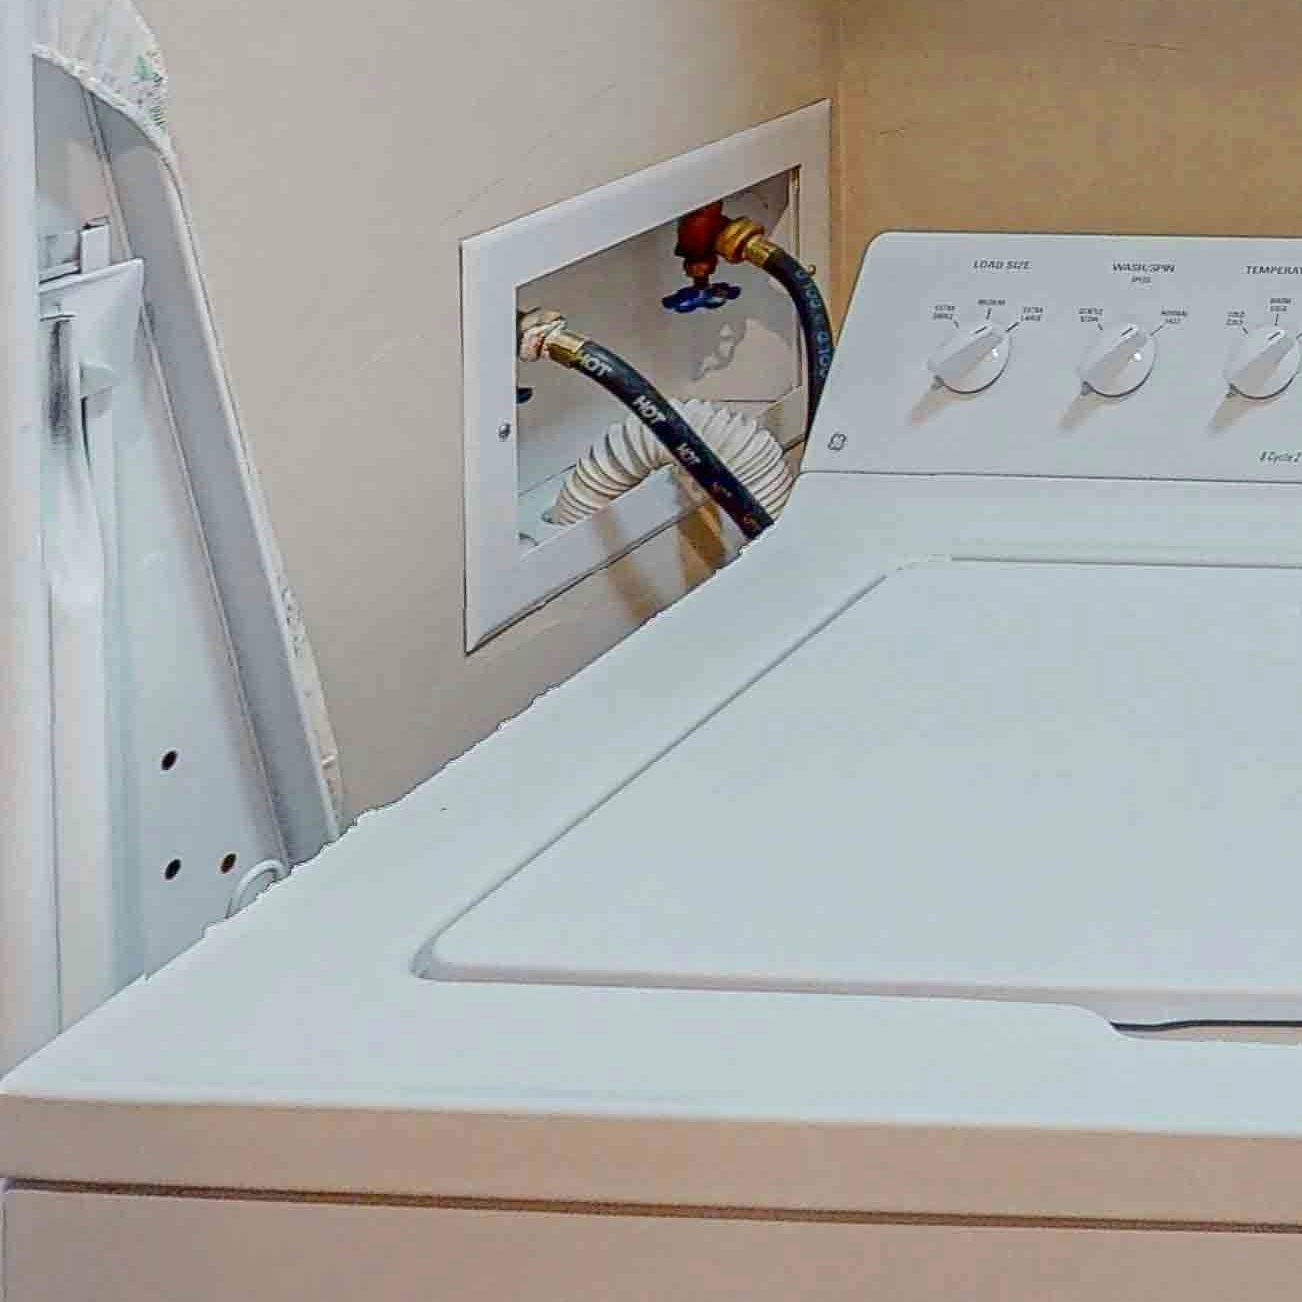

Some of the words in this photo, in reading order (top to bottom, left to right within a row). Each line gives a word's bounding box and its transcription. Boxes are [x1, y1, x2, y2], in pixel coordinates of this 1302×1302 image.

[974, 260, 1004, 269] LOAD
[1006, 260, 1031, 270] SIZE
[633, 395, 666, 424] HOT
